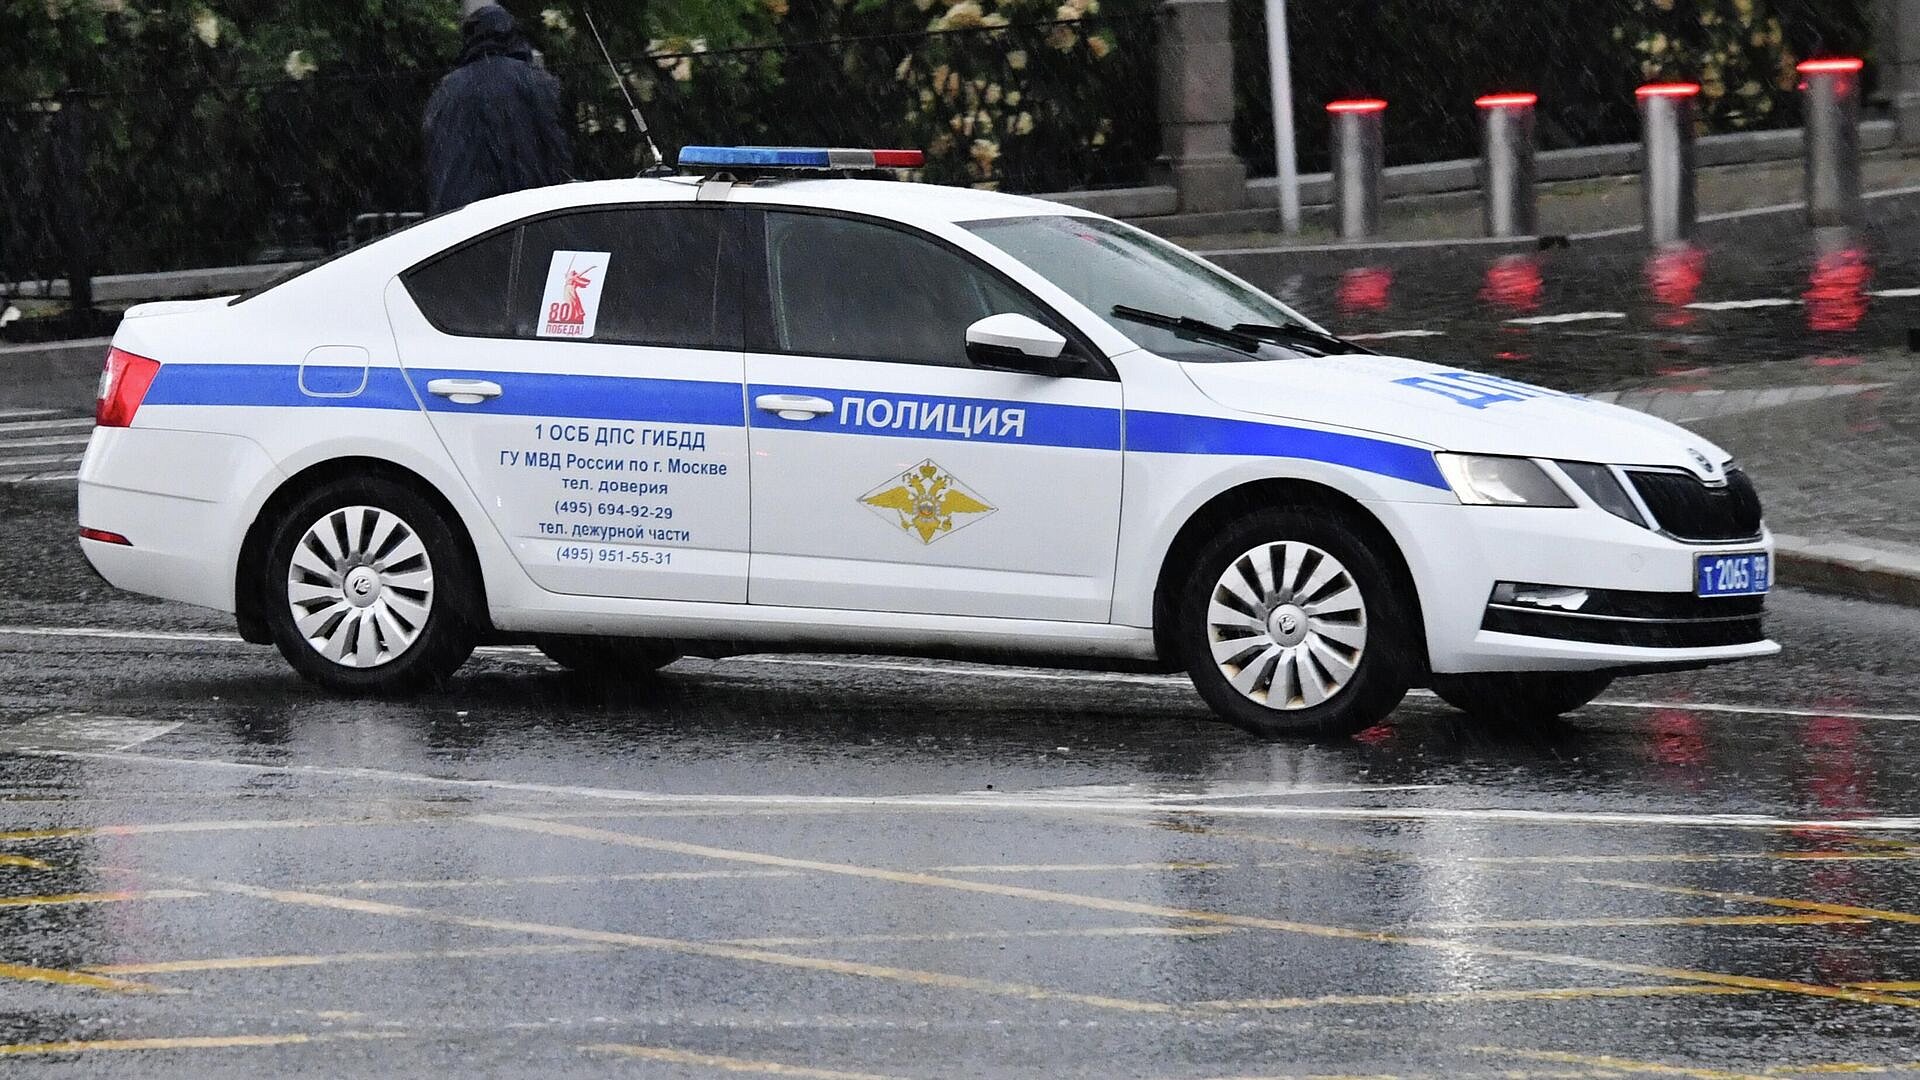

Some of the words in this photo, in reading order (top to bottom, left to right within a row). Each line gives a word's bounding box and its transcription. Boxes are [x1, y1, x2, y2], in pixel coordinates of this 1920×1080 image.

[548, 303, 570, 320] 80
[545, 324, 584, 335] ПОБЕДА!
[839, 396, 1026, 438] ПОЛИЦИЯ
[535, 424, 542, 440] 1
[549, 424, 590, 443] ОСБ
[595, 427, 635, 446] ДПС
[641, 429, 706, 451] ГИБДД
[499, 450, 520, 466] ГУ
[524, 452, 562, 470] МВД
[566, 454, 624, 471] России
[629, 459, 649, 472] по
[653, 461, 663, 473] г.
[668, 458, 728, 475] Москве
[562, 477, 593, 490] тел.
[598, 481, 668, 496] доверия
[554, 500, 593, 515] (495)
[598, 502, 673, 520] 694-92-29
[539, 521, 568, 535] тел.
[571, 524, 645, 541] дежурной
[649, 528, 690, 542] части
[556, 547, 594, 563] (495)
[598, 550, 672, 565] 951-55-31
